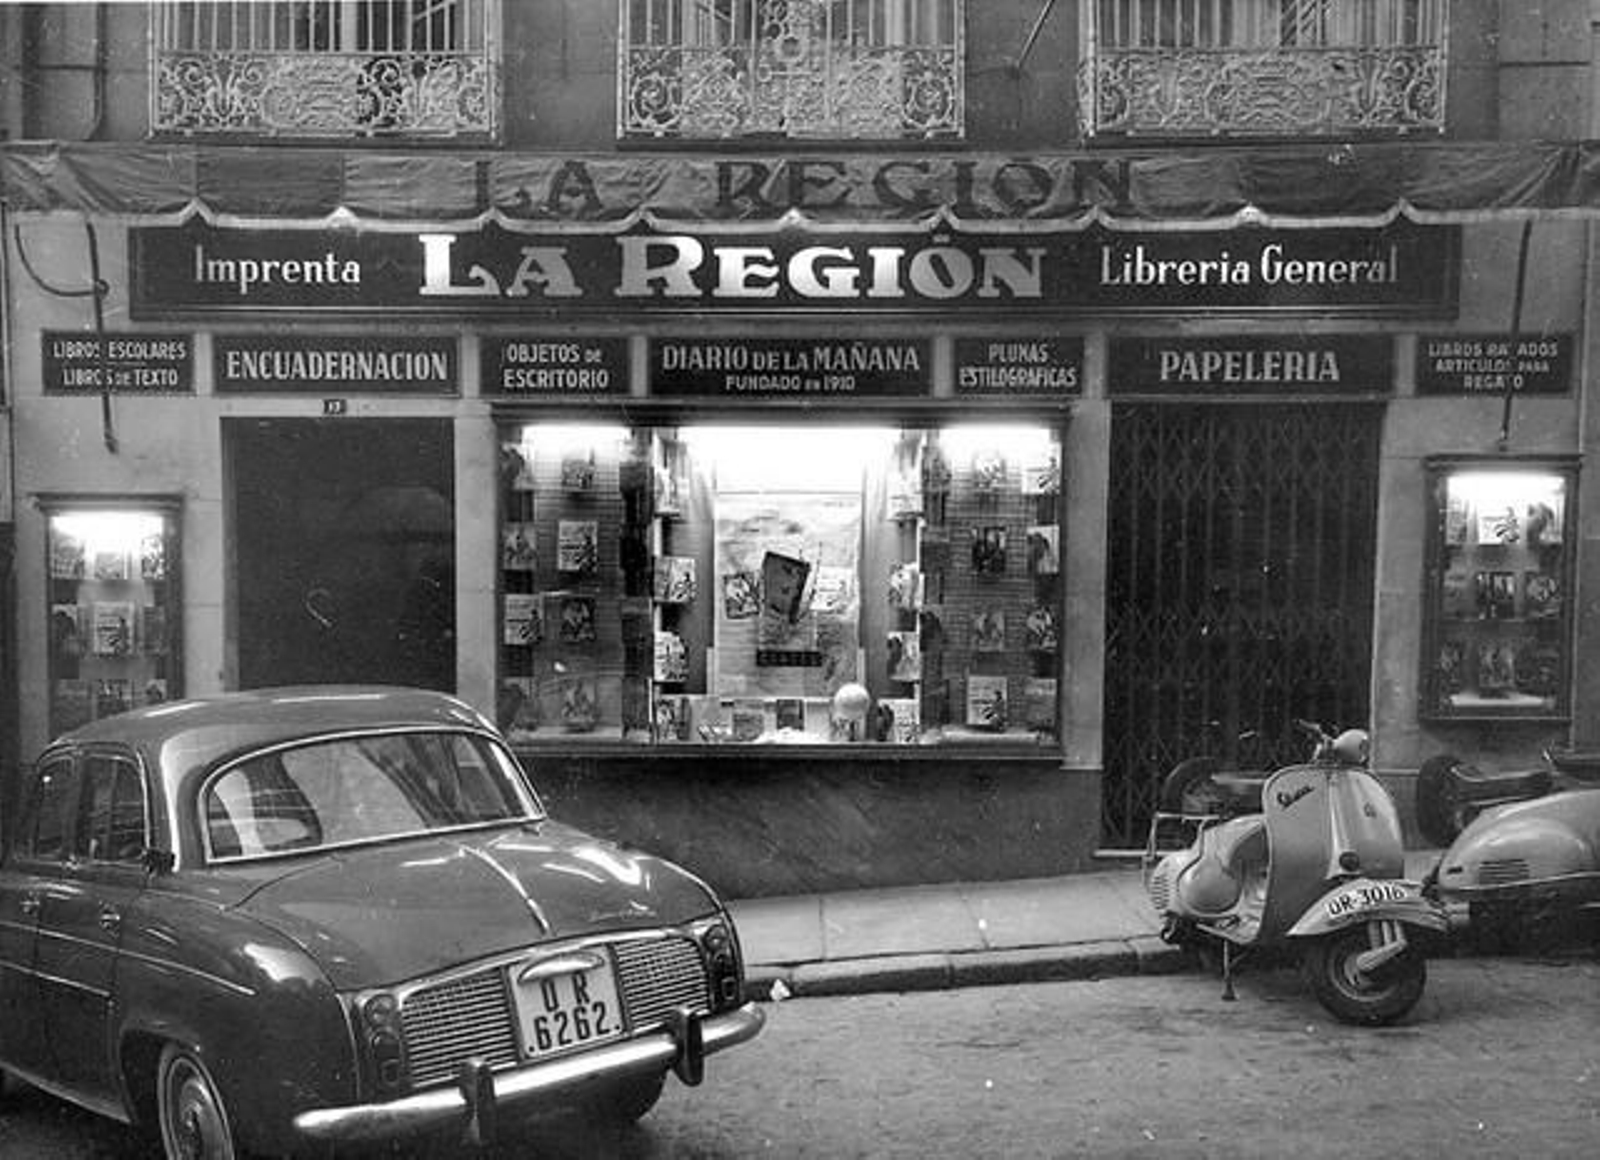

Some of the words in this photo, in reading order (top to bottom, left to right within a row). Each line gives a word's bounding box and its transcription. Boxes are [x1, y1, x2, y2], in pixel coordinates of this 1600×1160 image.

[196, 244, 361, 294] Imprenta
[419, 234, 583, 296] LA
[1260, 243, 1398, 285] General
[108, 341, 186, 360] ESCOLARES
[507, 343, 580, 363] OBJETOS
[662, 345, 749, 371] DIARIO
[812, 341, 920, 371] MAÑANA
[988, 343, 1048, 362] PLUMAS
[1428, 342, 1483, 358] LIBROS
[1486, 342, 1558, 358] RAADOS
[226, 350, 448, 380] ENCUADERNACION
[1159, 351, 1341, 382] PAPELERIA
[134, 368, 178, 386] TEXTO
[503, 369, 609, 389] ESCRITORIO
[725, 374, 801, 391] FUNDADO
[823, 375, 855, 391] 1910
[959, 366, 1077, 388] ESTILOGRAFICAS
[1463, 375, 1524, 390] REGAO
